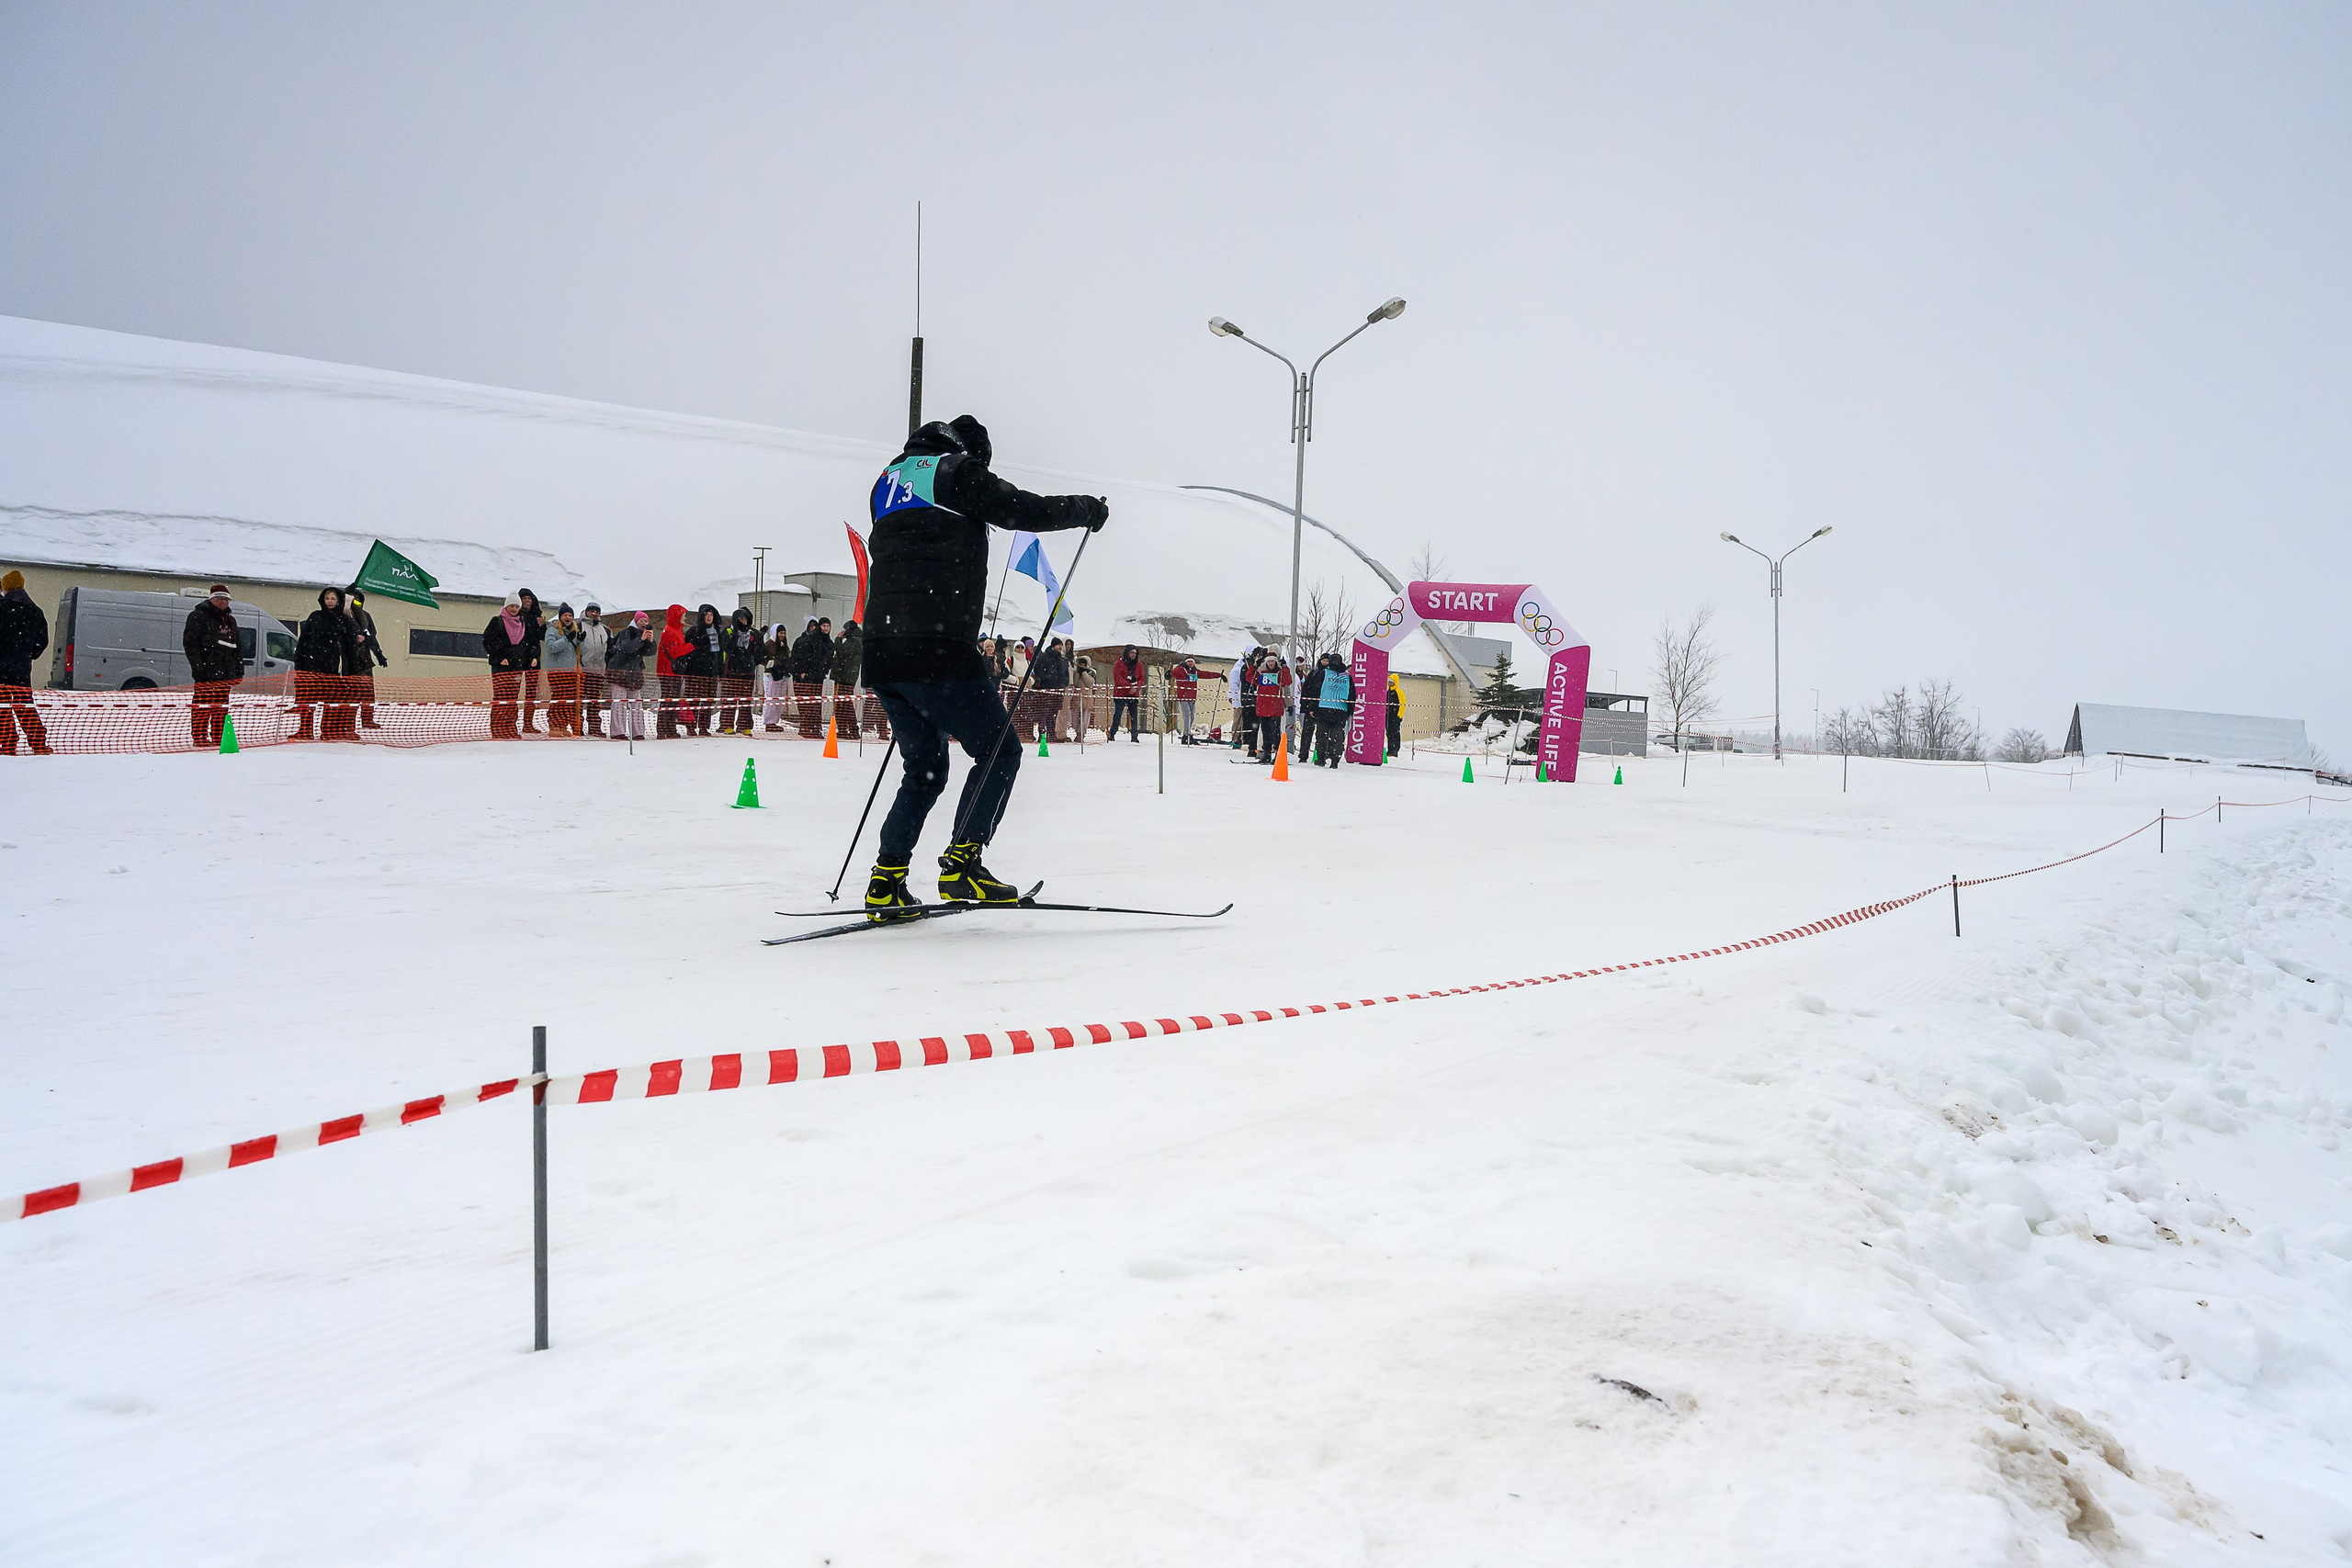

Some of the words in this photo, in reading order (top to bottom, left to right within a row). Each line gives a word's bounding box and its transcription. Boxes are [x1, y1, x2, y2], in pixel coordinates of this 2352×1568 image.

[1428, 590, 1499, 612] START
[1354, 652, 1367, 687] LIFE
[1547, 661, 1567, 729] ACTIVE
[1351, 693, 1366, 754] ACTIVE
[1544, 734, 1560, 772] LIFE
